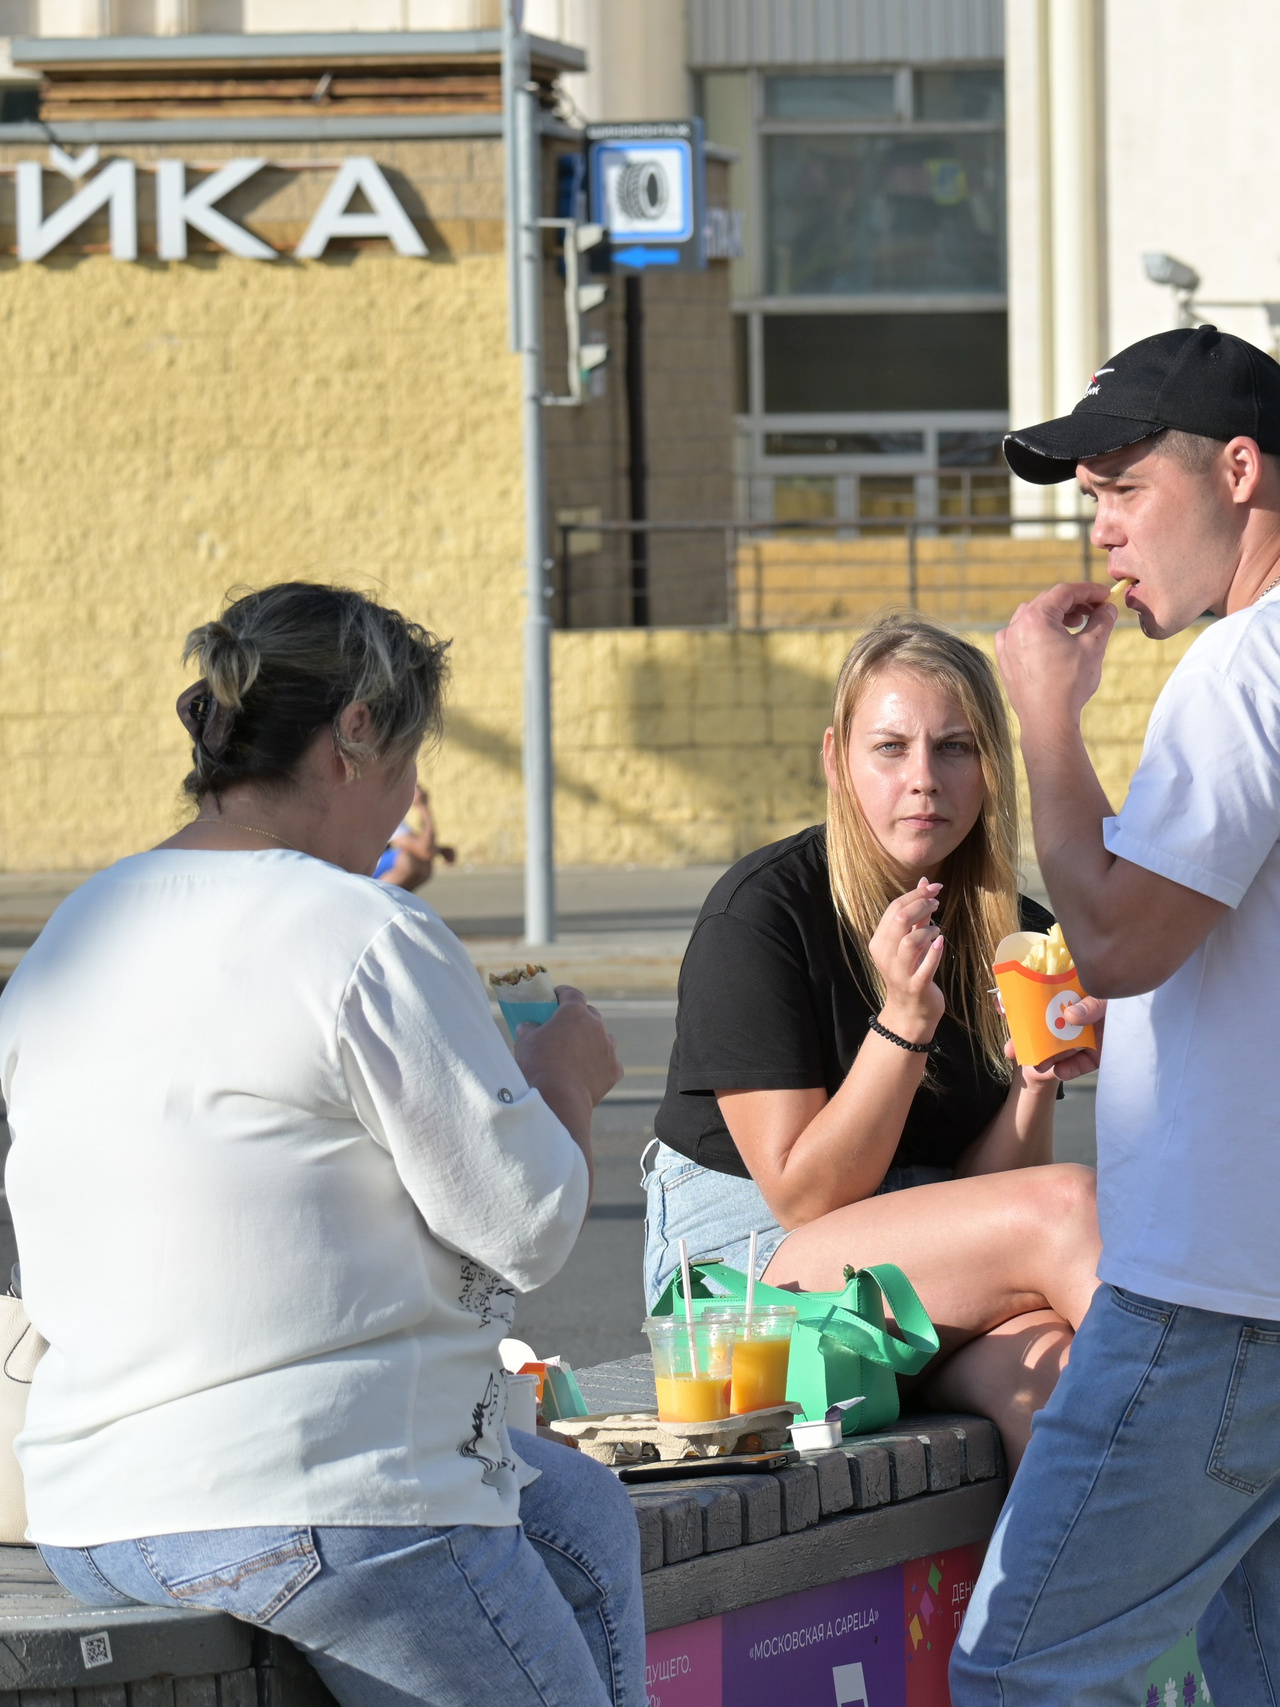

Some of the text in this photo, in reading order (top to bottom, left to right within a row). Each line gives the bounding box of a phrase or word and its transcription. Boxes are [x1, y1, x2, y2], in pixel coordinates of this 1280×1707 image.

[16, 143, 430, 262] ЙКА
[749, 1624, 824, 1661] «МОСКОВСКАЯ
[834, 1608, 880, 1637] CAPELLA»
